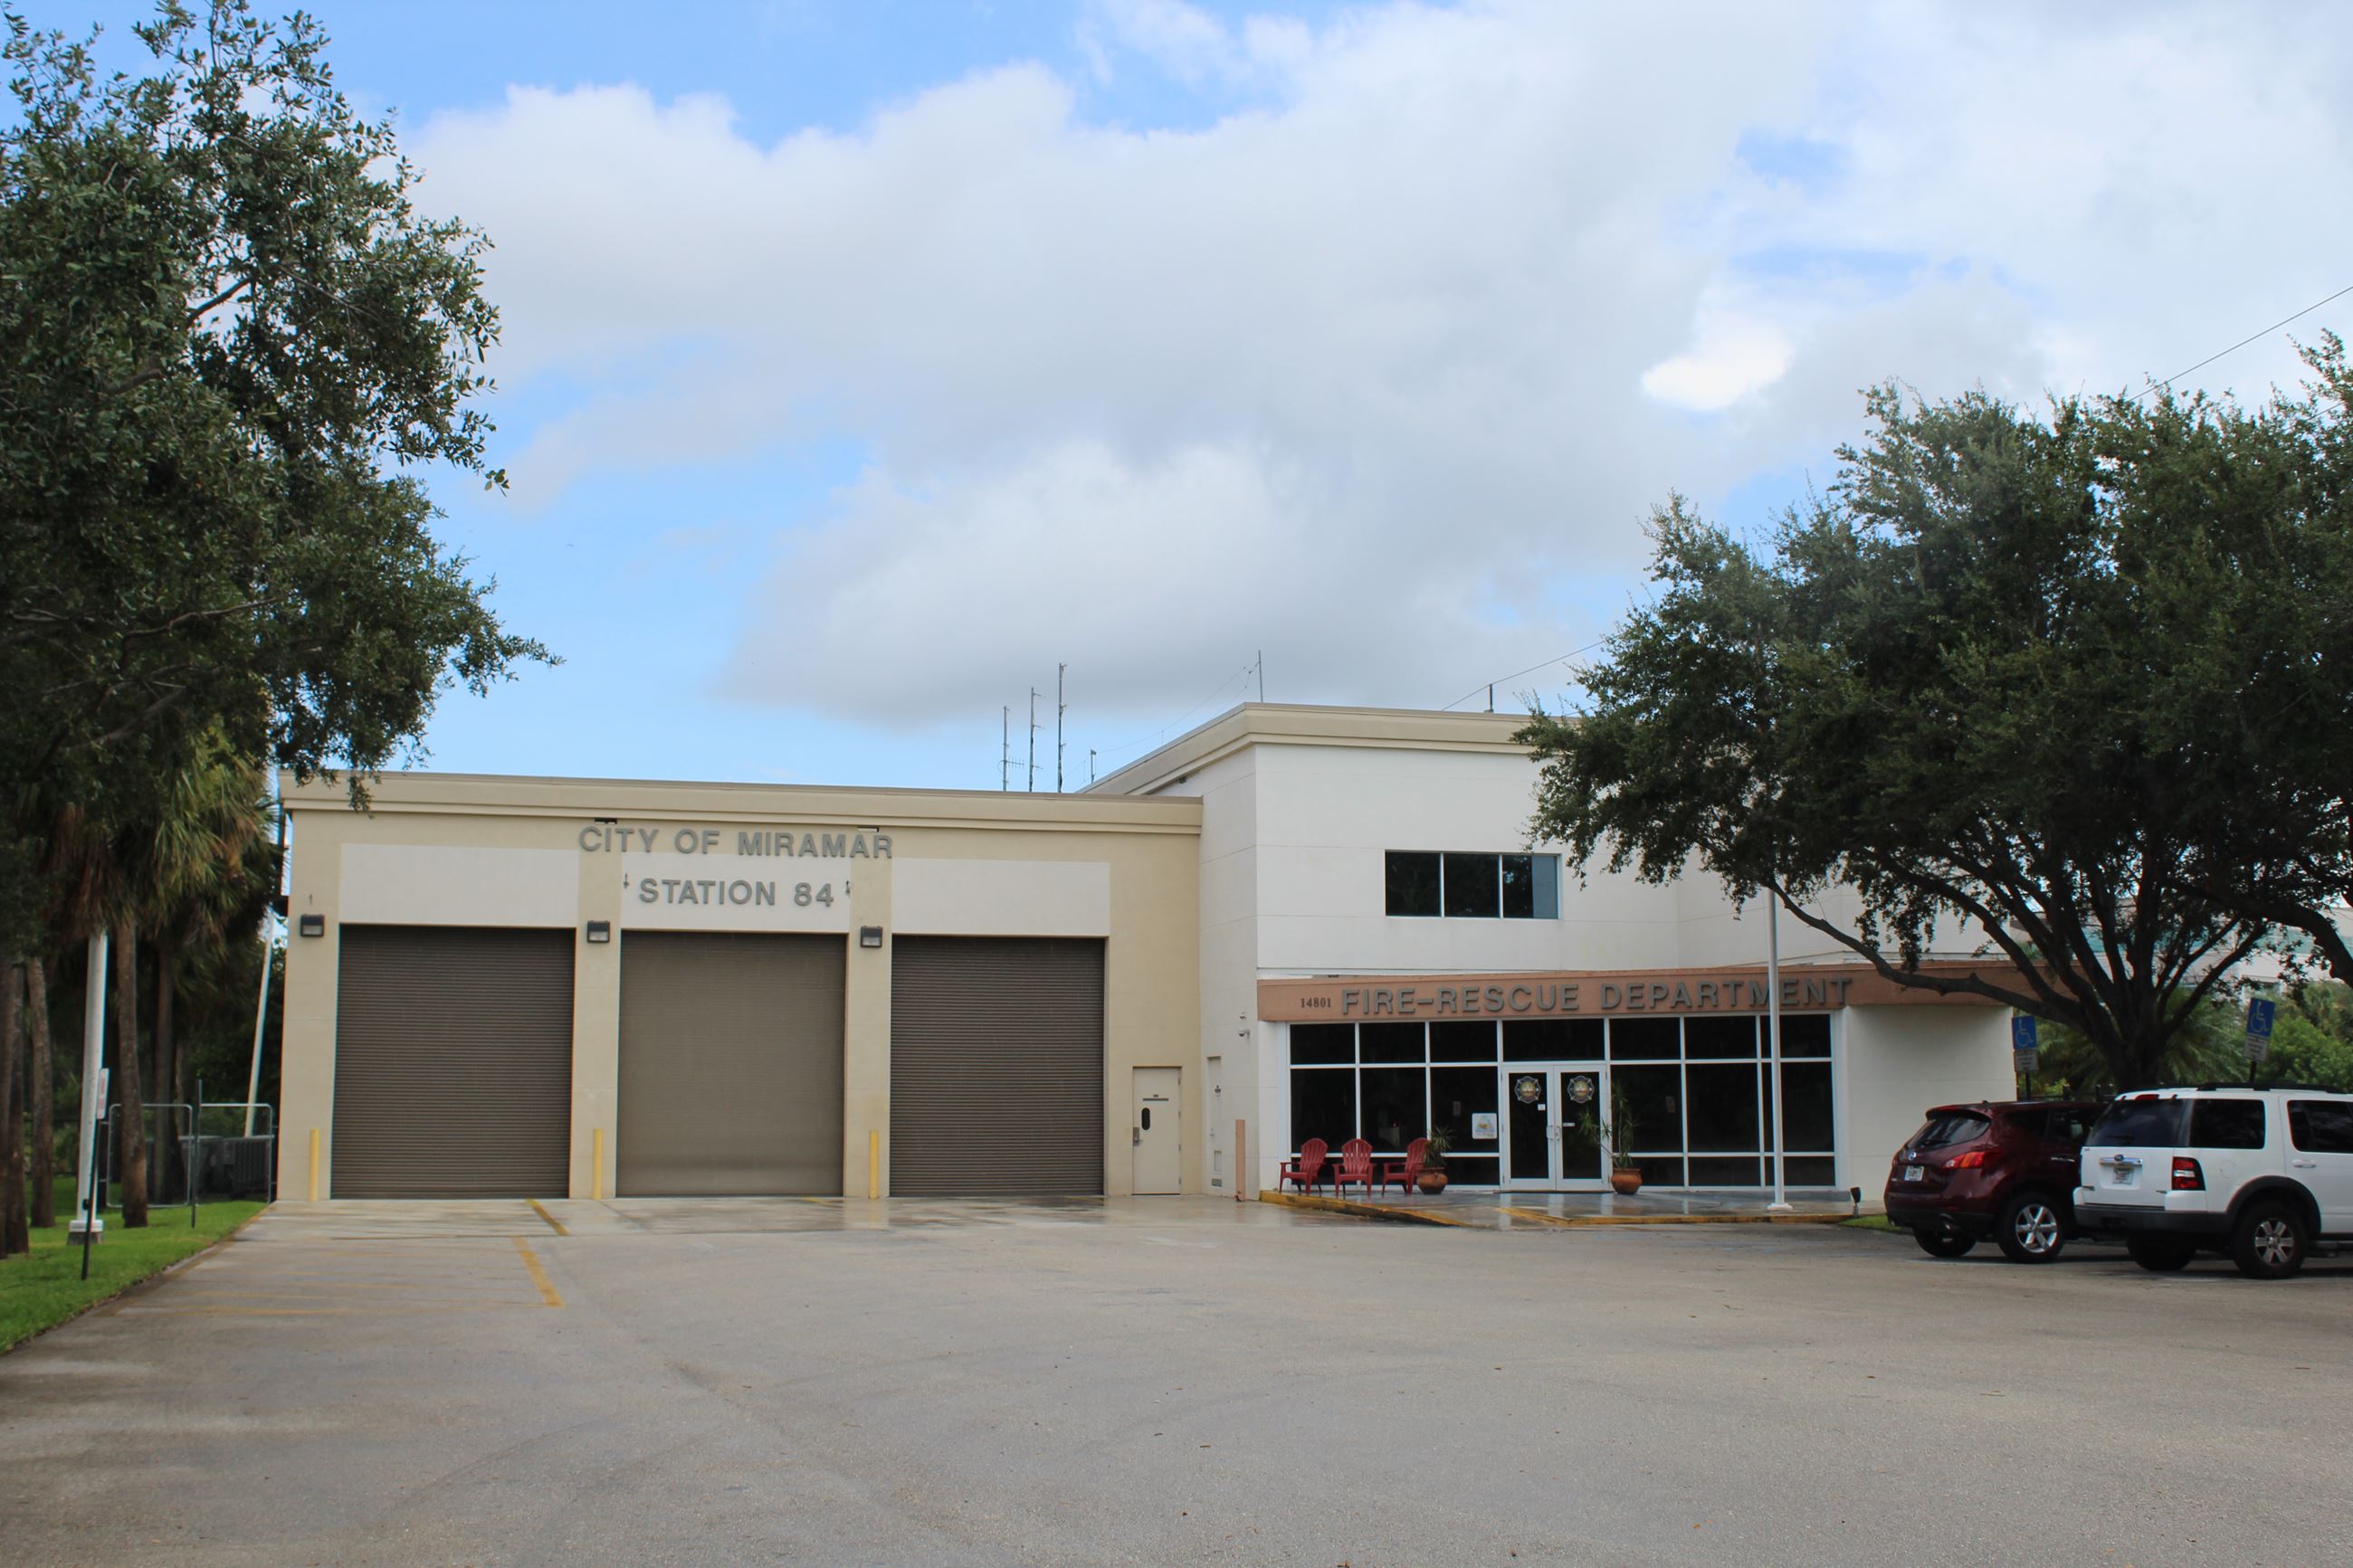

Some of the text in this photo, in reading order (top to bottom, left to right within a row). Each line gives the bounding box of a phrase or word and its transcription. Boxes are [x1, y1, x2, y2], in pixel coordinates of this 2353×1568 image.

[578, 826, 893, 859] CITY OF MIRAMAR
[639, 878, 834, 908] STATION 84
[1300, 997, 1332, 1009] 14801
[1342, 977, 1853, 1015] FIRE-RESCUE DEPARTMENT
